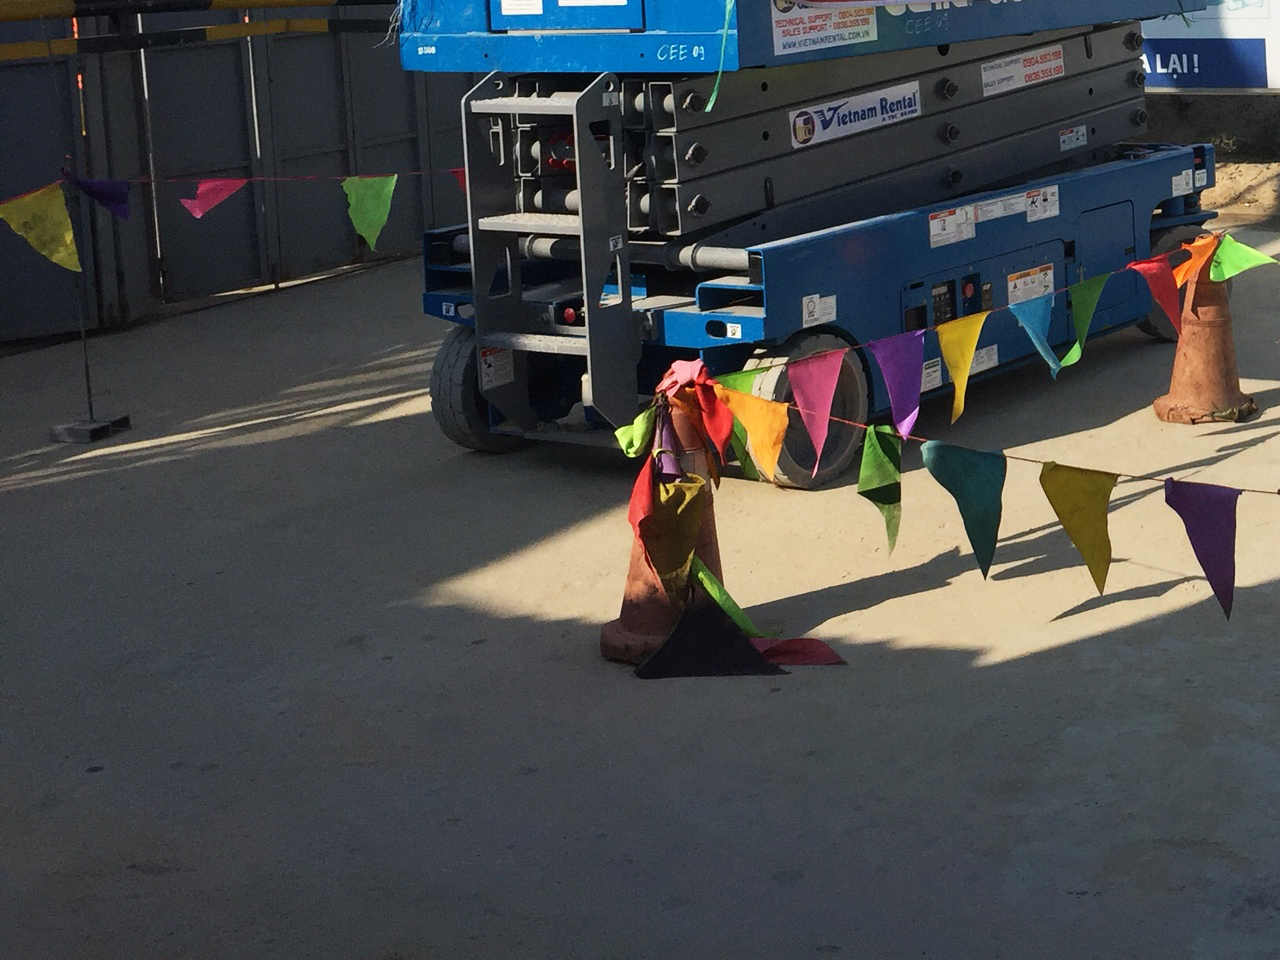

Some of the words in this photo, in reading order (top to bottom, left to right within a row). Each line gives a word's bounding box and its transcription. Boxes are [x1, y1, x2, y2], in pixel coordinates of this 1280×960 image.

[807, 13, 833, 24] SUPPORT
[802, 24, 828, 35] SUPPORT
[657, 43, 688, 61] CEE
[1156, 53, 1188, 79] LẠI
[813, 101, 878, 131] Vietnam
[880, 93, 916, 116] Rental
